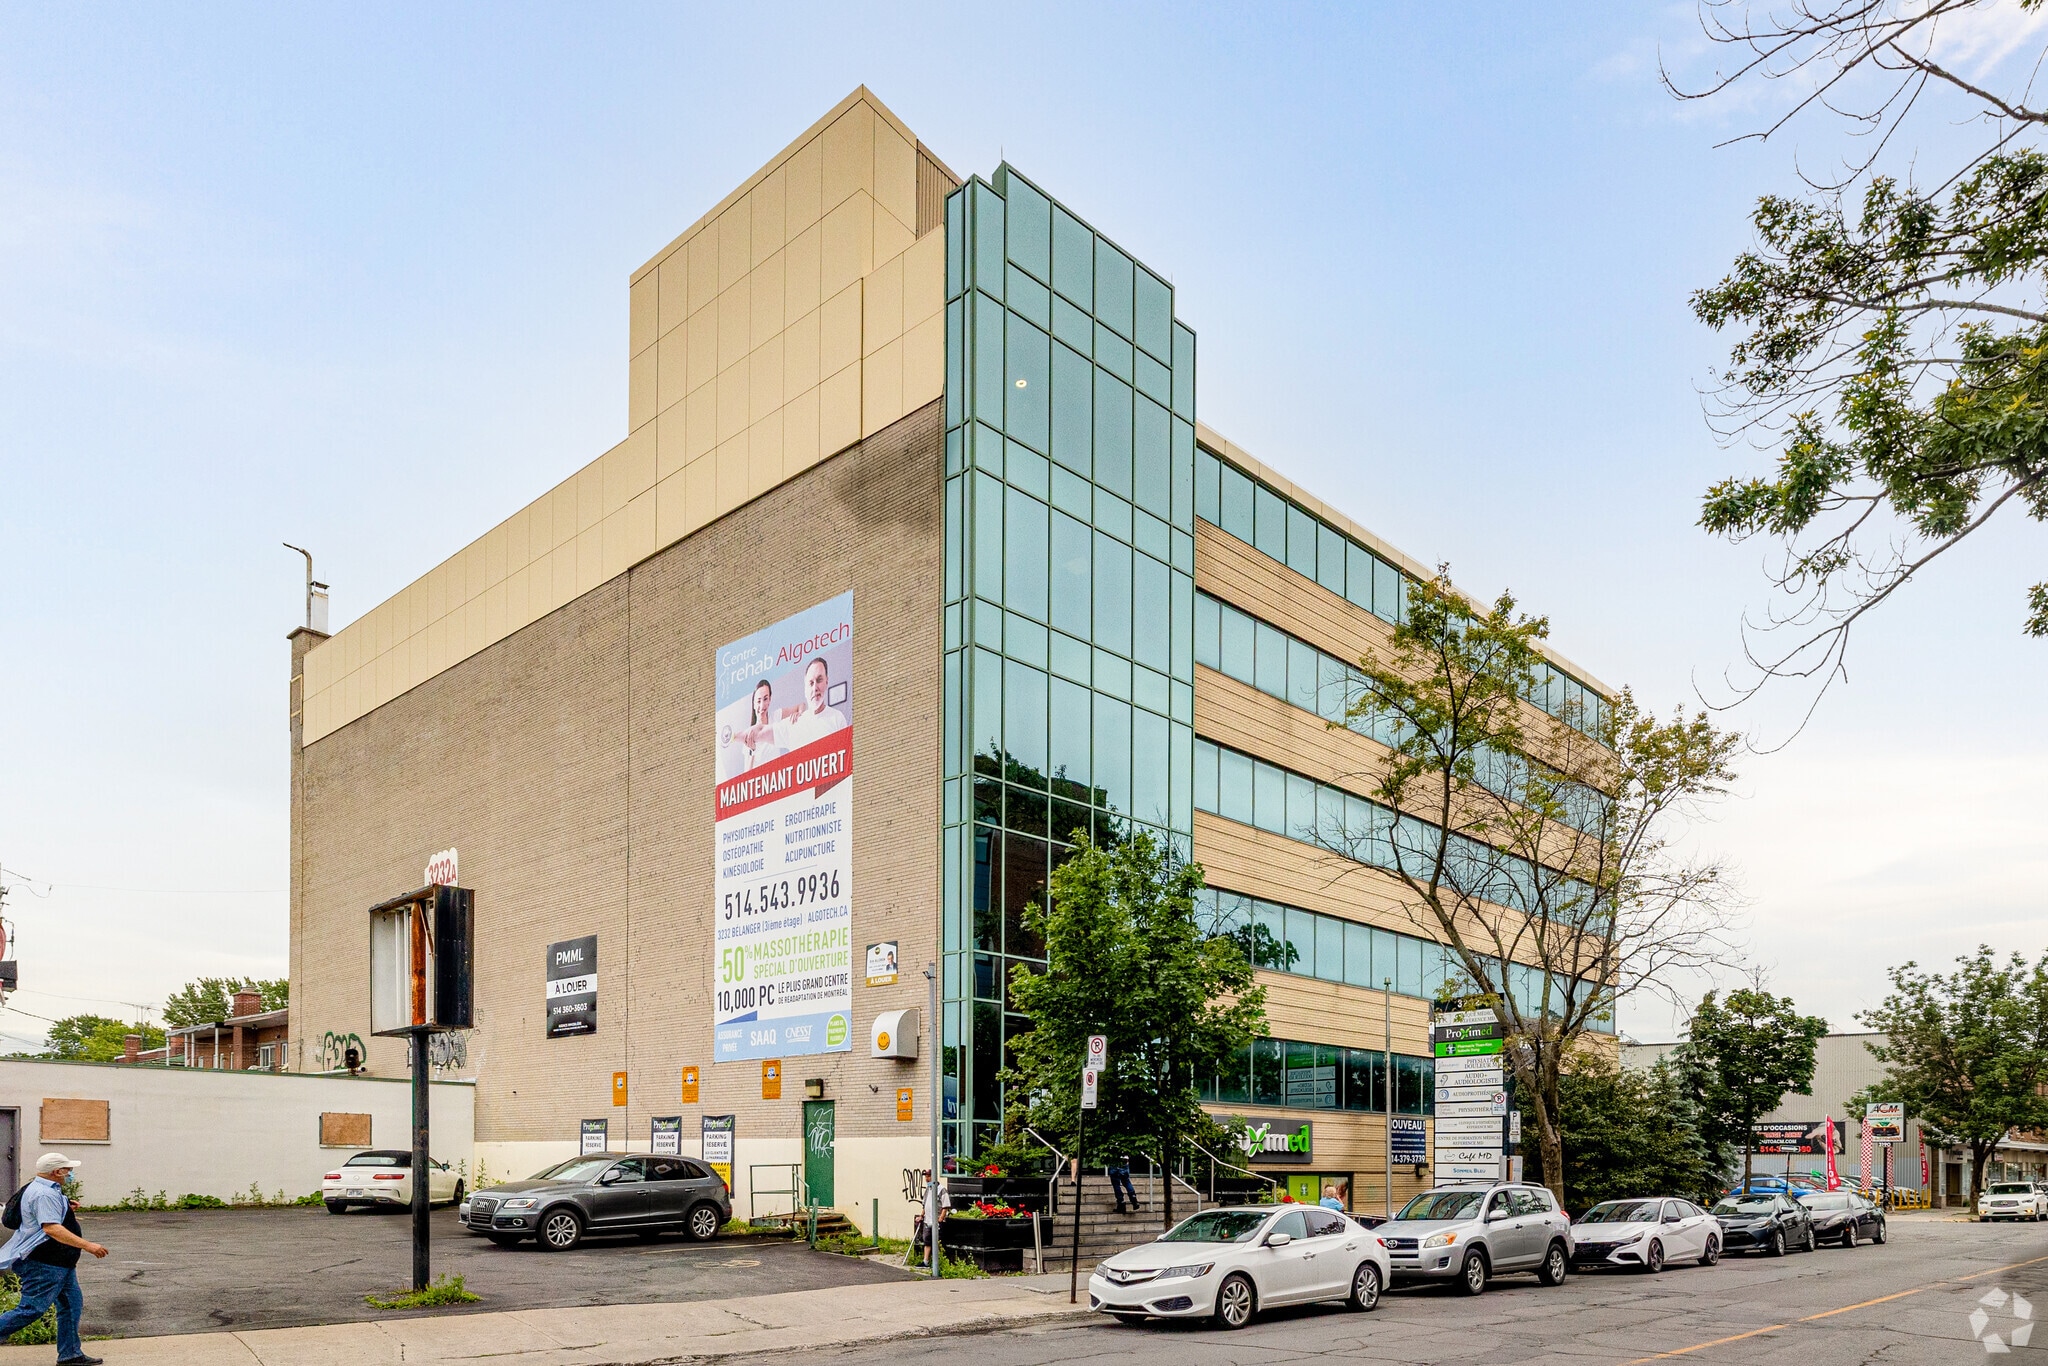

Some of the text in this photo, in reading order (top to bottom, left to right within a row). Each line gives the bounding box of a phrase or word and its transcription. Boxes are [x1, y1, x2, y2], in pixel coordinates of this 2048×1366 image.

[722, 646, 758, 668] Centre
[731, 622, 850, 684] rehab Algotech
[720, 750, 846, 809] MAINTENANT OUVERT
[785, 802, 836, 827] ERGOTHÉRAPIE
[723, 820, 774, 844] PHYSIOTHÉRAPIE
[785, 820, 842, 845] NUTRITIONNISTE
[723, 841, 764, 862] OSTÉOPATHIE
[785, 840, 835, 863] ACUPUNCTURE
[429, 858, 456, 885] 3232A
[723, 858, 764, 879] KINÉSIOLOGIE
[725, 869, 840, 920] 514.543.9936
[718, 928, 730, 940] 3232
[732, 922, 760, 937] BÉLANGER
[808, 905, 848, 922] ALGOTECH.CA
[754, 926, 848, 960] MASSOTHÉRAPIE
[556, 948, 584, 966] PMML
[754, 950, 848, 980] SPÉCIAL D'OUVERTURE
[555, 980, 588, 994] À LOUER
[778, 973, 848, 994] LE PLUS GRAND CENTRE
[718, 984, 774, 1012] 10,000 PC
[817, 992, 823, 1000] DE
[553, 1006, 562, 1015] 514
[718, 1029, 742, 1040] ASSURANCE
[750, 1028, 776, 1046] SAAQ
[786, 1024, 812, 1039] CNESST
